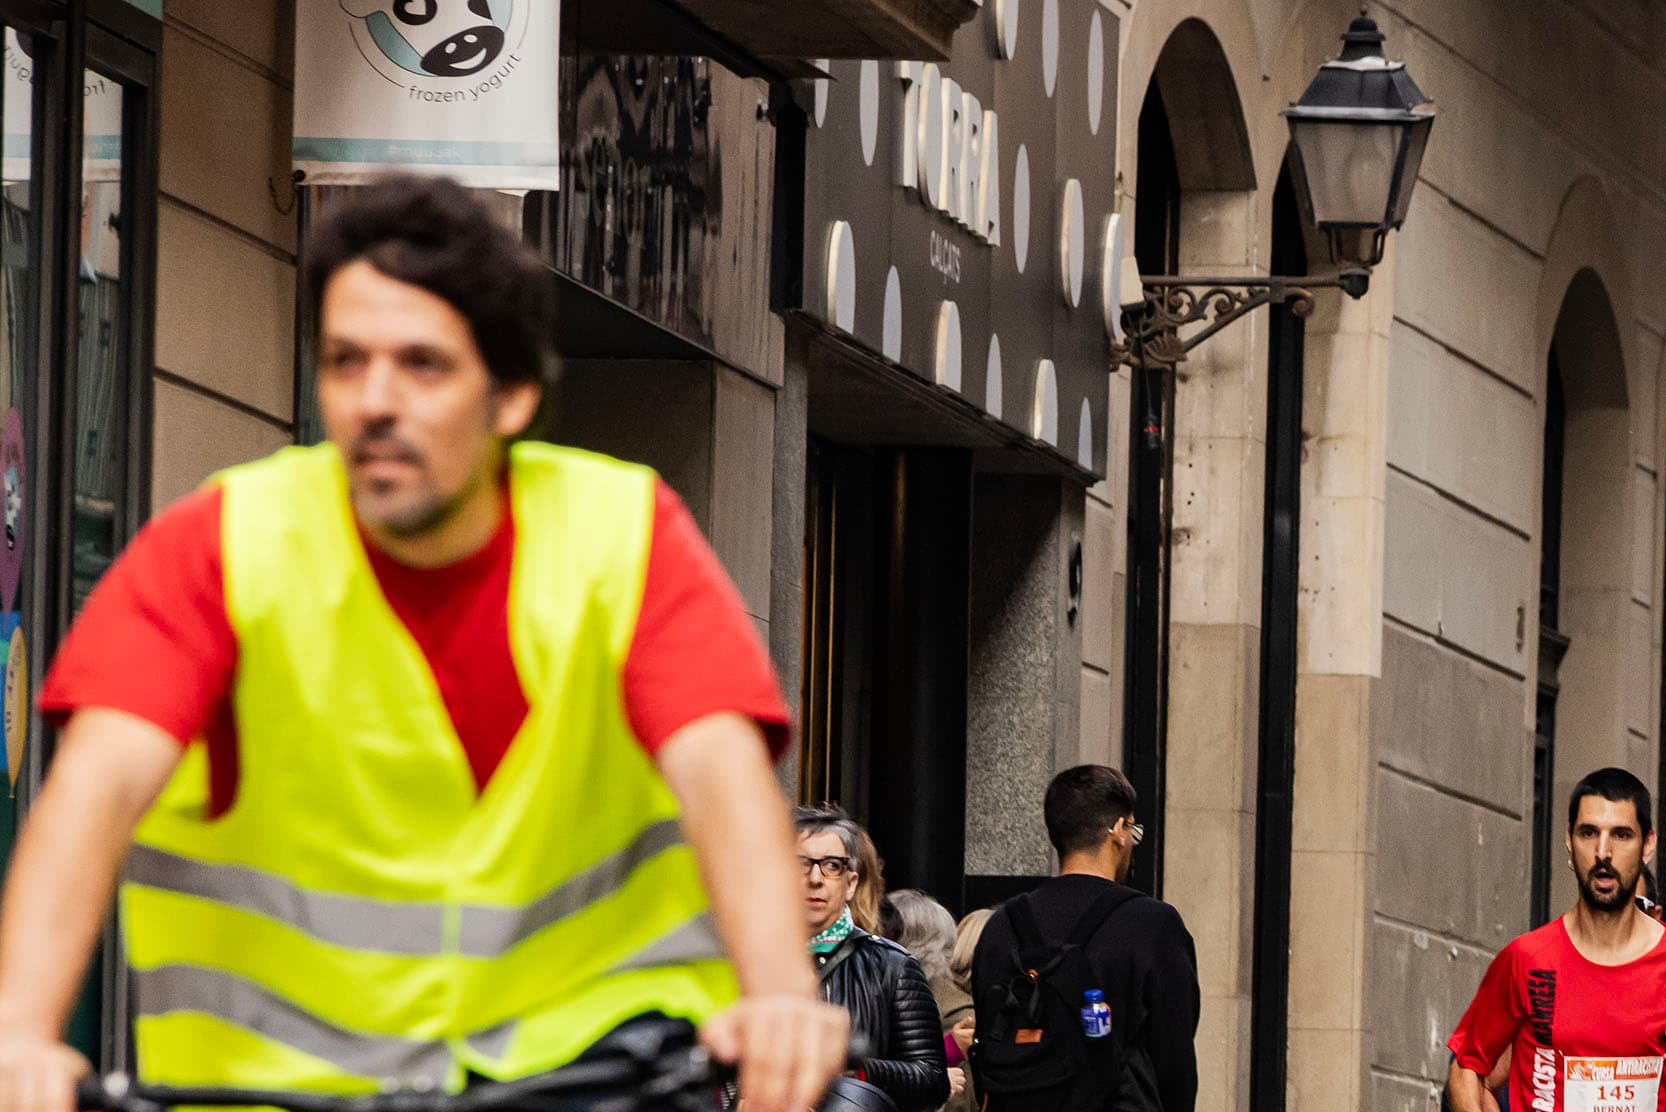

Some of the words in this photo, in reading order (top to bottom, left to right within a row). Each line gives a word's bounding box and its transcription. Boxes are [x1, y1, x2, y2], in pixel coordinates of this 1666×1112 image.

[409, 86, 466, 102] frozen
[469, 54, 521, 101] yogurt
[897, 60, 1000, 247] TORRA
[930, 230, 961, 285] CALÇATS
[1528, 968, 1557, 1046] MANRESA
[1597, 1085, 1636, 1101] 145
